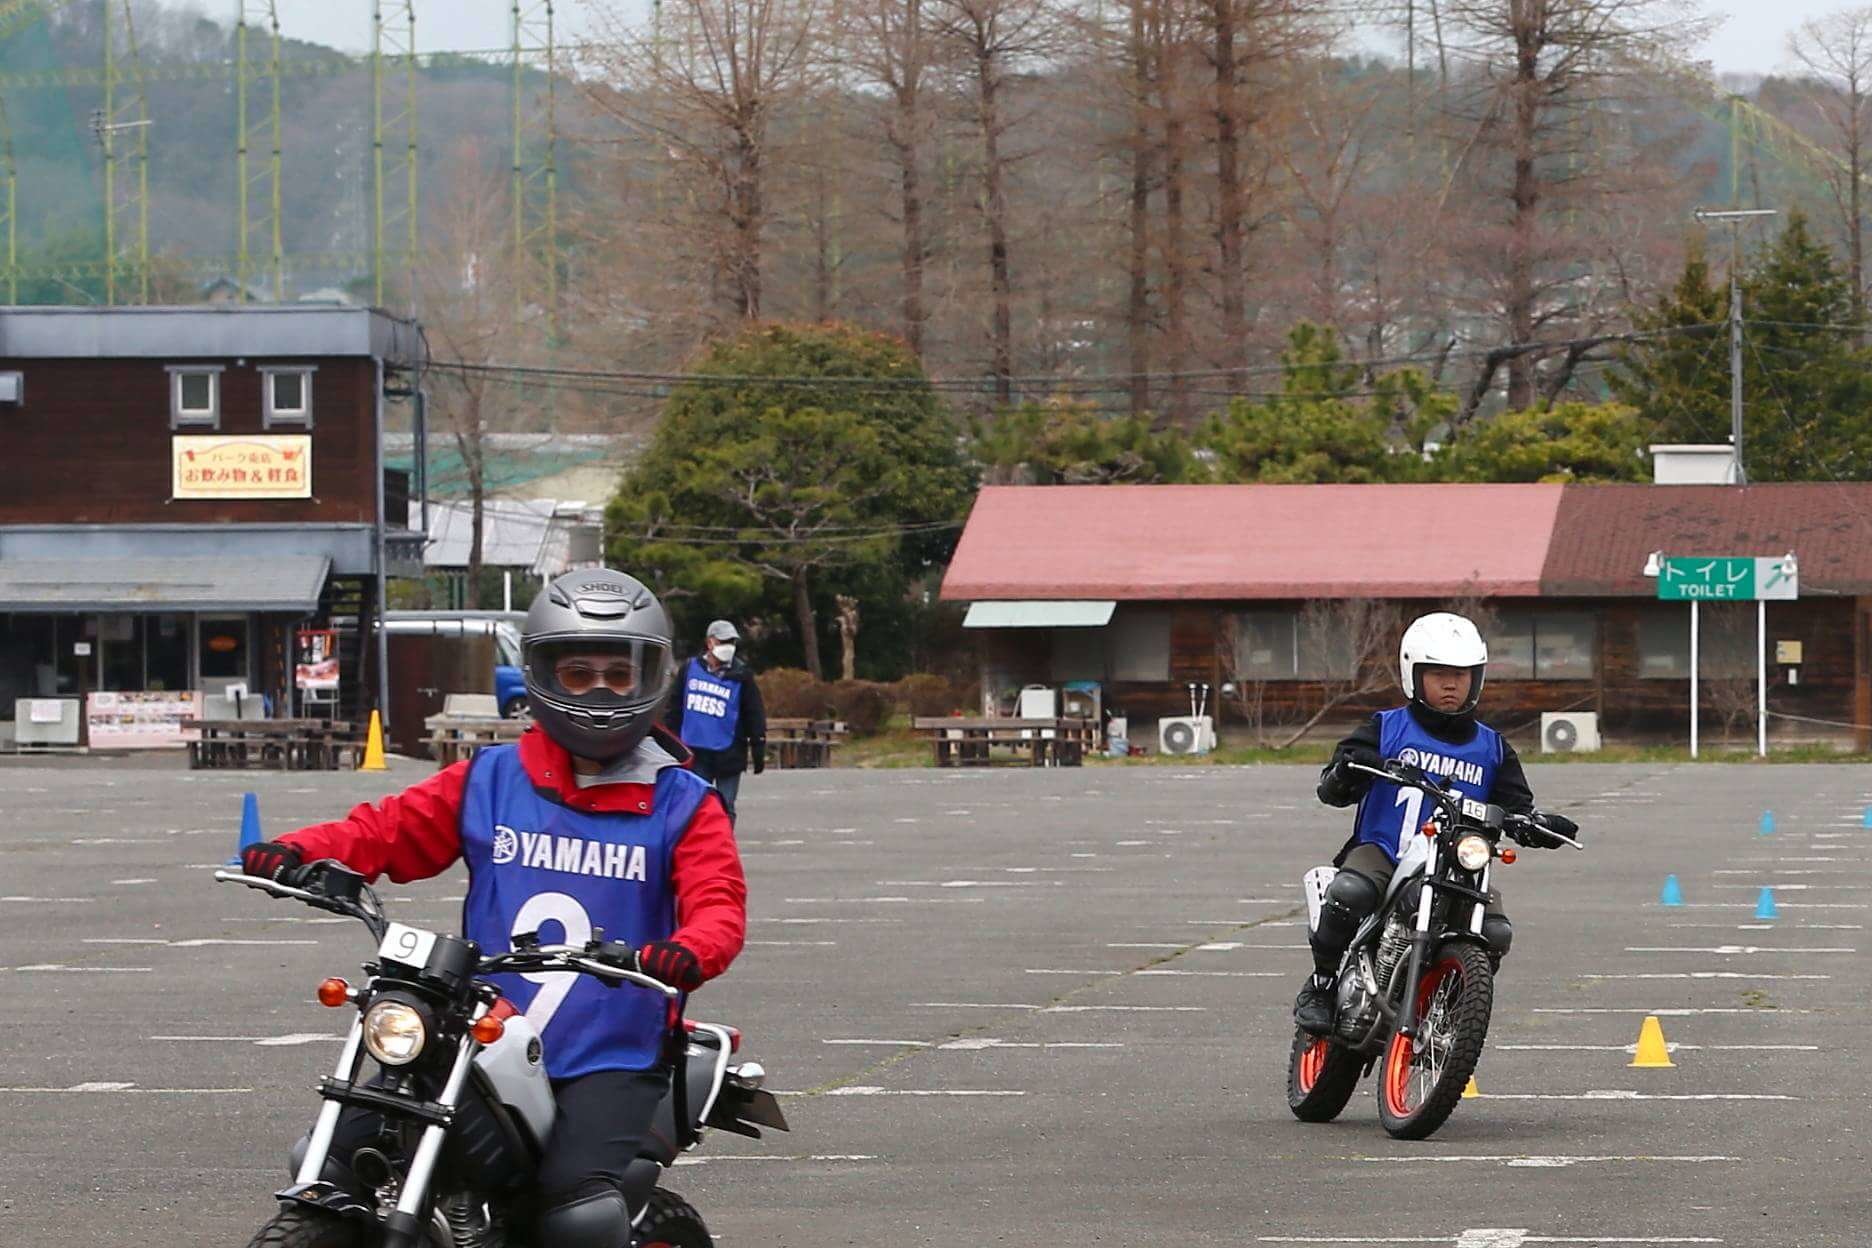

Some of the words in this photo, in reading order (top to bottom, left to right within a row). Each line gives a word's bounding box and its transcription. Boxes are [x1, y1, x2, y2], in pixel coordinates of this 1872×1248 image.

[1666, 561, 1748, 582] トイレ
[582, 583, 623, 594] SHOEI
[1678, 584, 1736, 597] TOILET
[687, 693, 727, 717] PRESS
[1420, 751, 1483, 786] YAMAHA
[1467, 801, 1484, 818] 16
[520, 832, 646, 882] YAMAHA
[395, 931, 418, 958] 9
[510, 891, 592, 1036] 9
